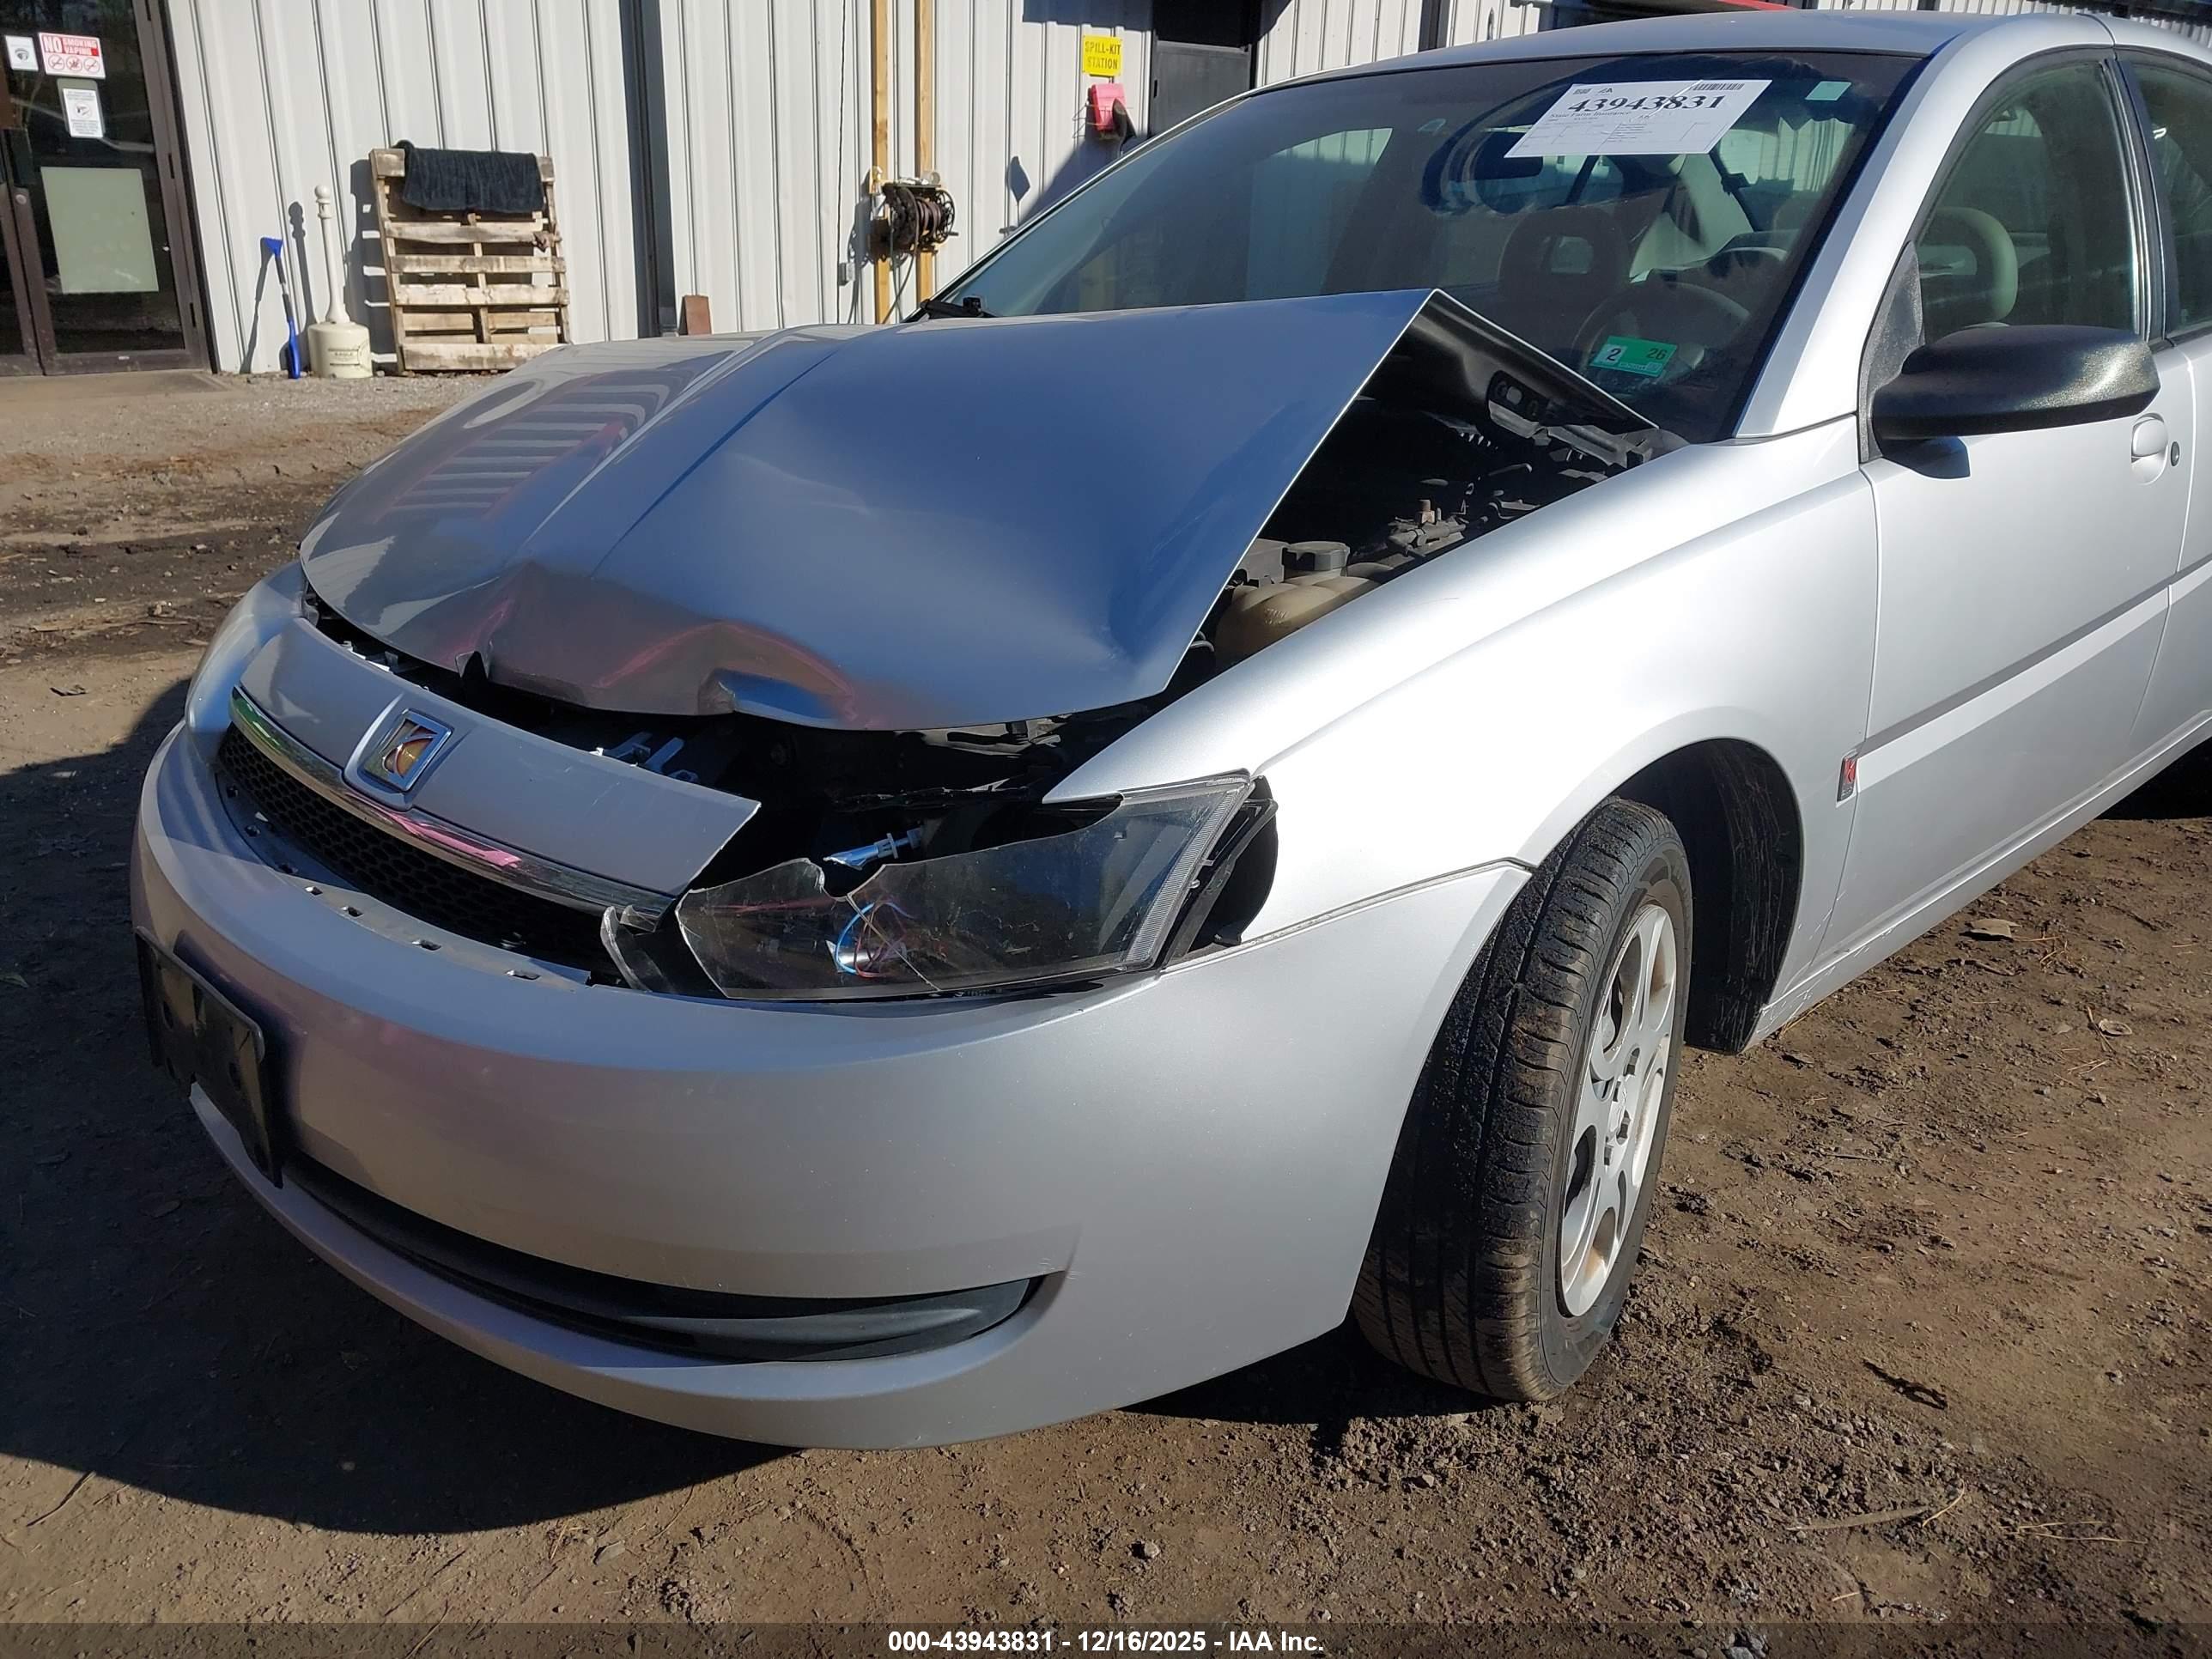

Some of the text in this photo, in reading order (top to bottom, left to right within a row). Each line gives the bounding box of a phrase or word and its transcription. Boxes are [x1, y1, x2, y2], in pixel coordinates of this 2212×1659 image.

[43, 35, 63, 53] NO
[1085, 40, 1121, 55] SPILL-KIT
[1087, 56, 1118, 70] STATION
[1567, 94, 1726, 112] 43943831
[1606, 347, 1668, 362] 2 26
